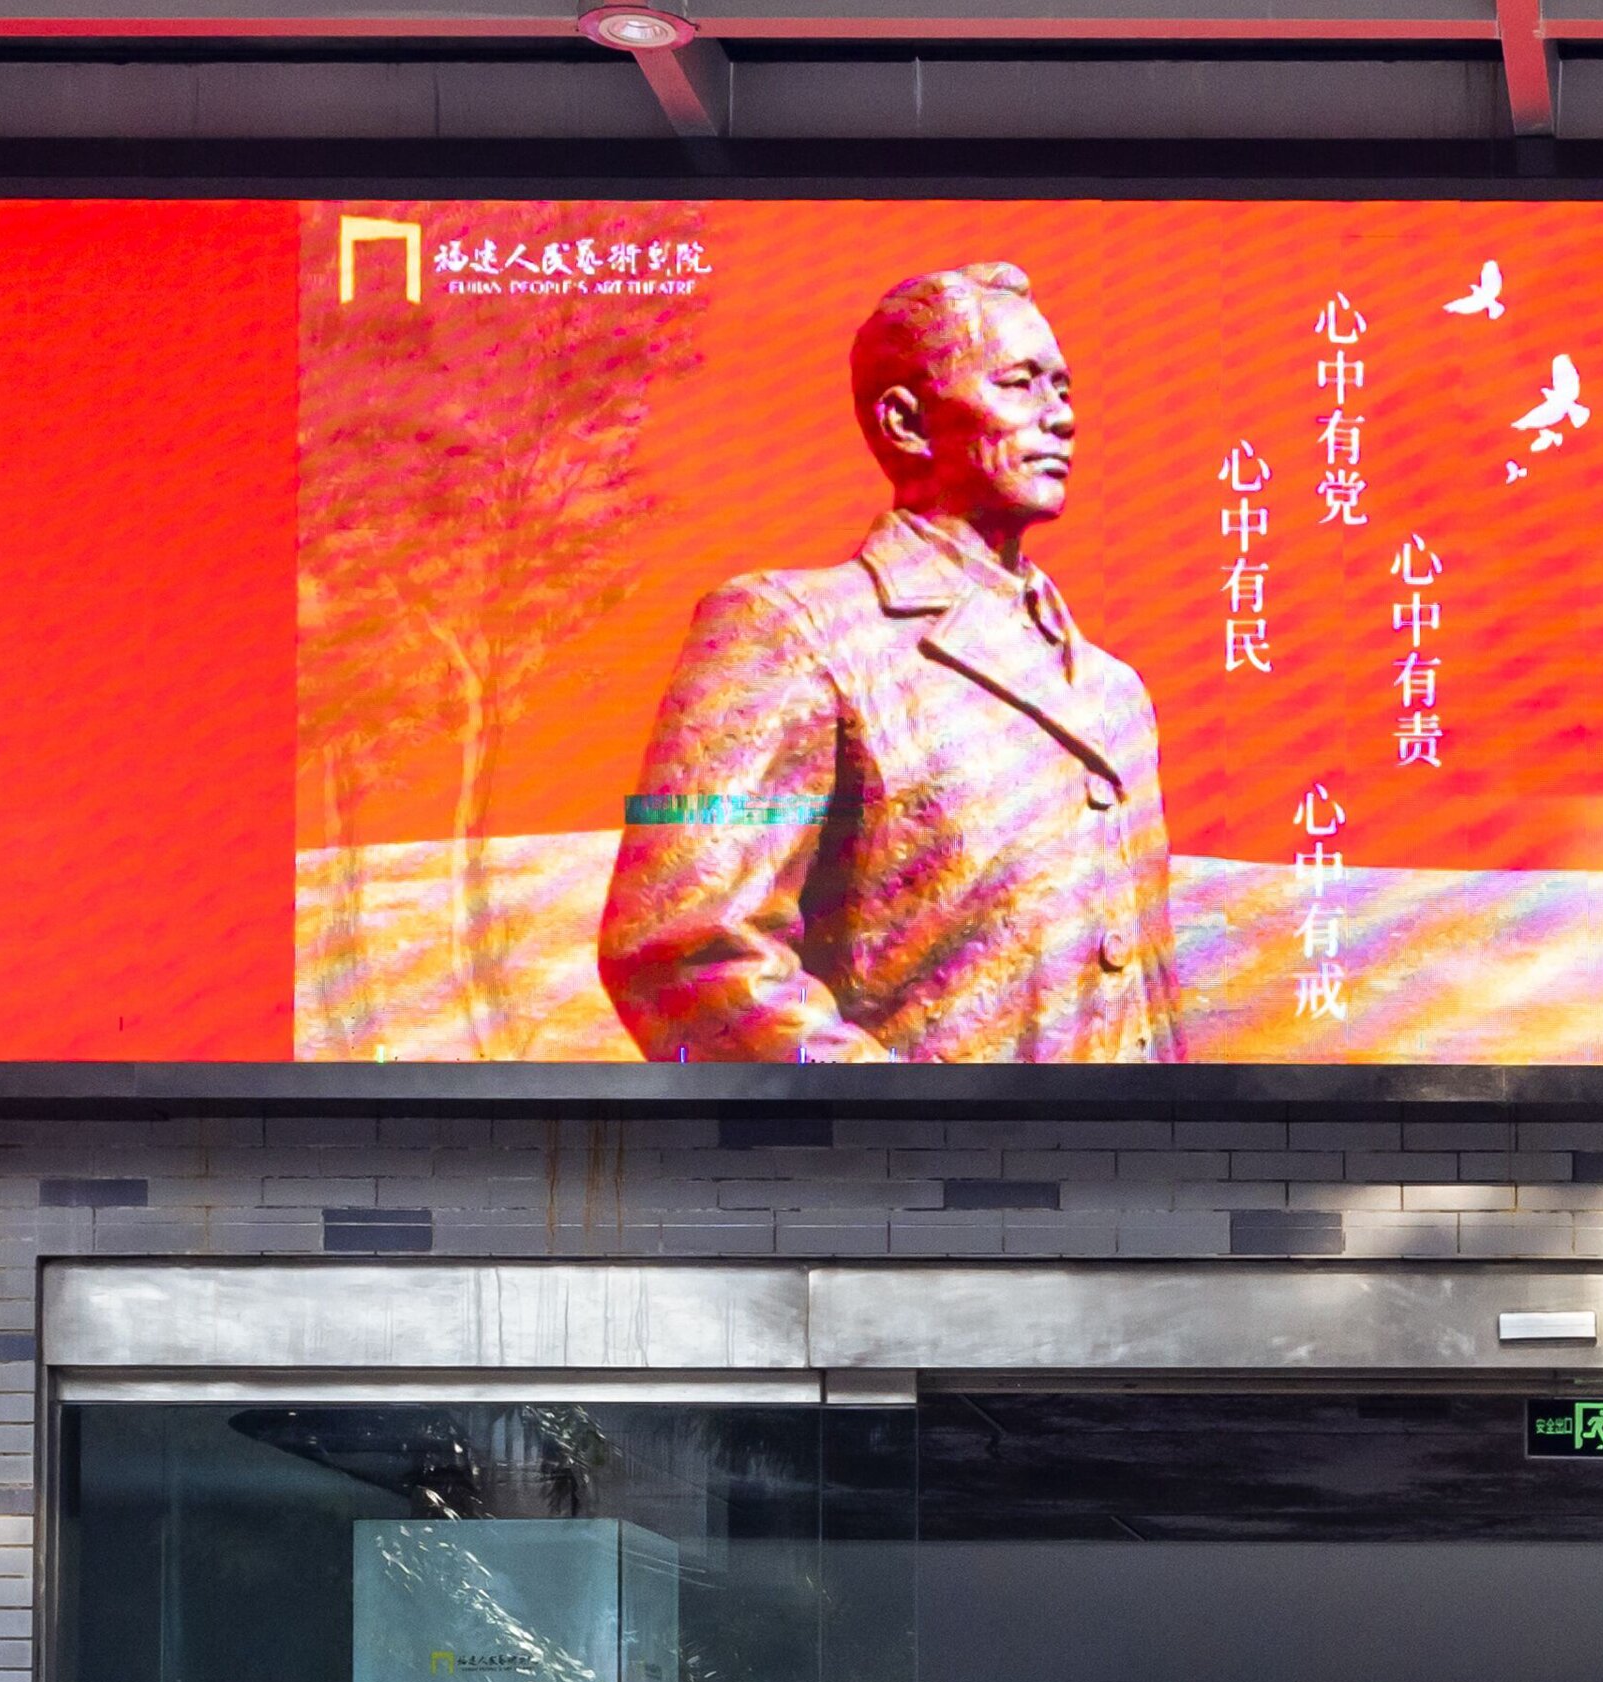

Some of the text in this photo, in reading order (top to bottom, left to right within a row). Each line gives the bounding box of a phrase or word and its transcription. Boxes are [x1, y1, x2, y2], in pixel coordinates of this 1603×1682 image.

[593, 281, 622, 295] ART
[626, 281, 695, 295] THEATRE
[1314, 289, 1369, 528] 心中有党
[1217, 439, 1273, 675] 心中有民
[1389, 532, 1444, 769] 心中有责
[1291, 783, 1348, 1023] 心中有戒
[1535, 1417, 1573, 1435] 安全出口
